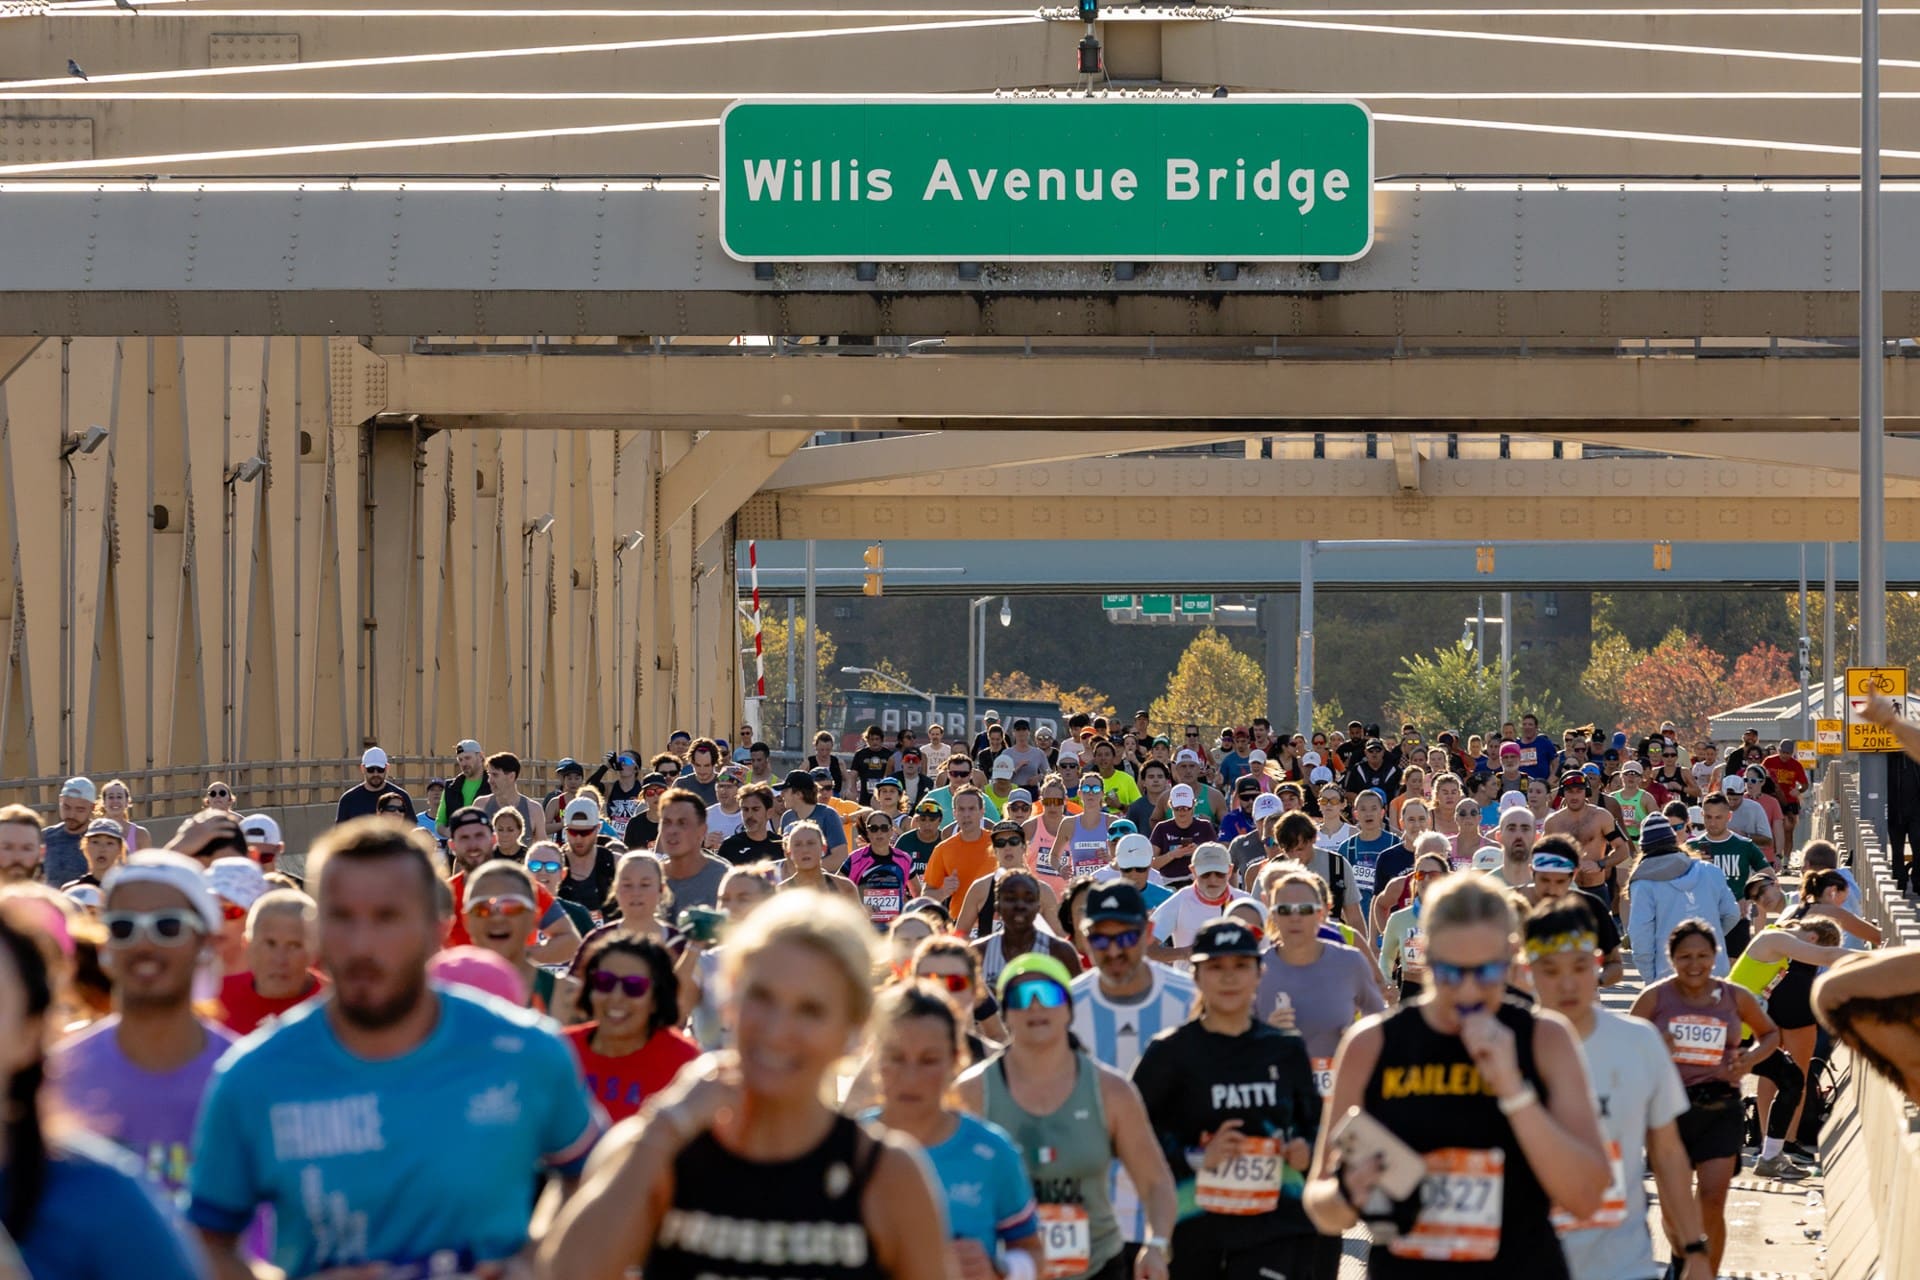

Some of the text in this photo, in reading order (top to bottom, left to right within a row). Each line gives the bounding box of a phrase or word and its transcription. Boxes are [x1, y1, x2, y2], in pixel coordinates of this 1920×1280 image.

[743, 158, 1351, 216] Willis Avenue Bridge
[1854, 725, 1893, 736] SHARE
[1862, 737, 1893, 748] ZONE
[1675, 1024, 1722, 1043] 51967
[1211, 1082, 1277, 1110] PATTY
